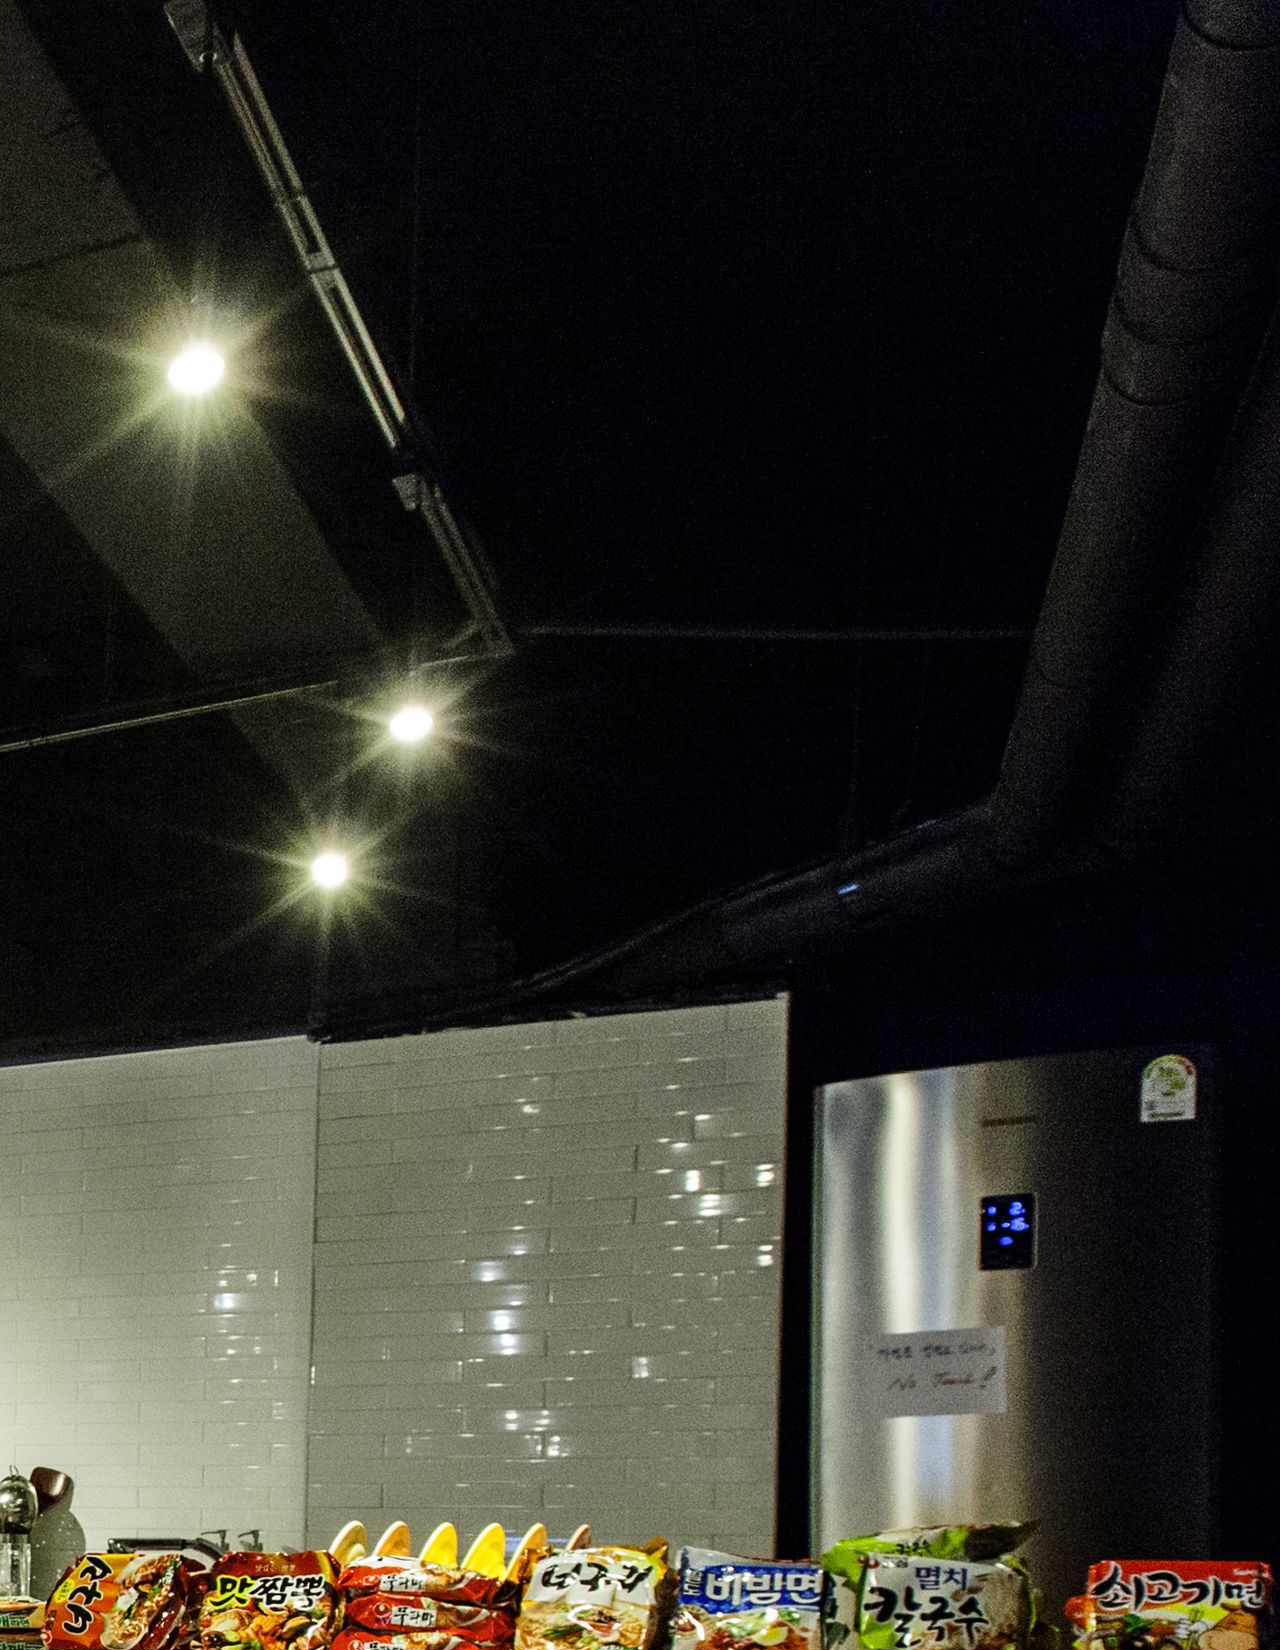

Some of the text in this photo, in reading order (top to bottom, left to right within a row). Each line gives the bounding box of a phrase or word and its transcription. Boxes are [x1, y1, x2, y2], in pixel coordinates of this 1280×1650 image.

[209, 1576, 324, 1609] 맛짬뽕
[542, 1562, 653, 1593] 너구리
[705, 1572, 822, 1606] 비빔면
[915, 1566, 968, 1591] 멸치
[1092, 1563, 1265, 1608] 쇠고기면
[62, 1556, 113, 1634] 너구리
[864, 1586, 988, 1649] 칼국수
